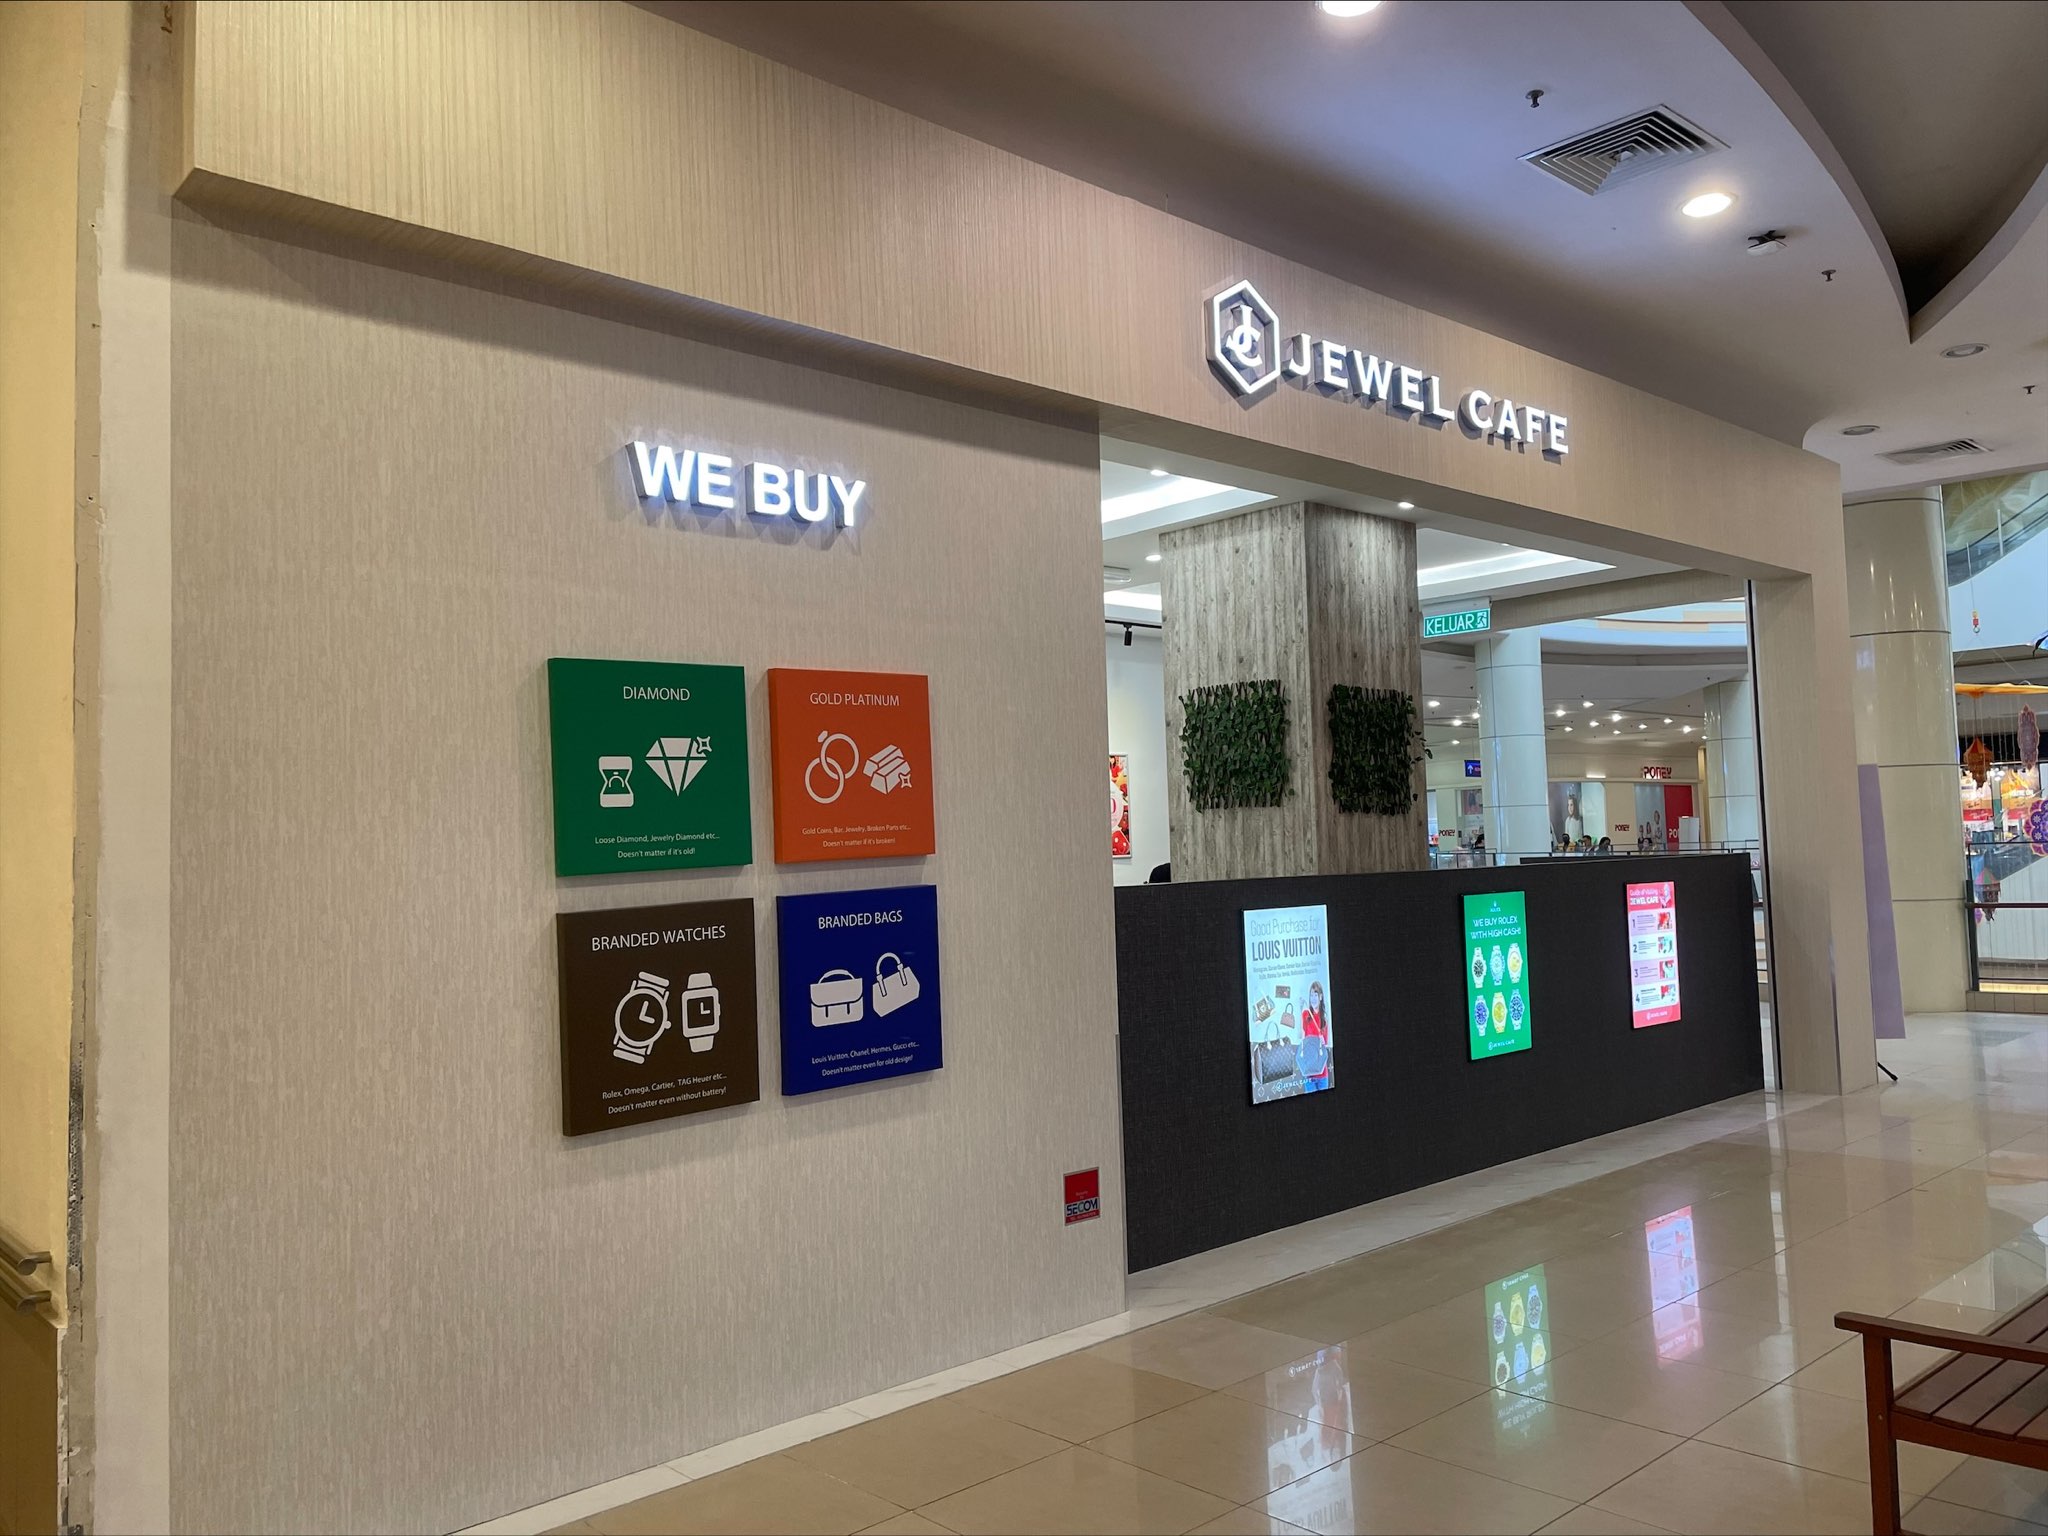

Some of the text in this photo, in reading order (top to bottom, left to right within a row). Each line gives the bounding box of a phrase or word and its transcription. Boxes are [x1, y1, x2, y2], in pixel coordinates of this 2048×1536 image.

[1288, 333, 1569, 455] JEWEL CAFE
[631, 441, 866, 528] WE BUY
[1426, 614, 1475, 635] KELUAR
[623, 686, 691, 701] DIAMOND
[810, 692, 900, 706] GOLD PLATINUM
[594, 836, 616, 845] Loose
[616, 835, 649, 844] Diamond,
[650, 834, 675, 844] Jewelry
[675, 832, 705, 841] Diamond
[802, 826, 816, 835] Gold
[823, 840, 844, 848] Doesn't
[876, 837, 896, 845] broken!
[617, 850, 644, 858] Doesn't
[645, 848, 667, 857] matter
[683, 847, 696, 855] old!
[818, 910, 903, 929] BRANDED BAGS
[1250, 919, 1271, 937] Good
[1272, 917, 1308, 935] Purchase
[1473, 915, 1518, 927] WE BUY ROLEX
[591, 925, 726, 951] BRANDED WATCHES
[1470, 930, 1487, 939] WITH
[1487, 929, 1503, 938] HIGH
[1251, 936, 1322, 961] LOUIS VUITTON
[811, 1057, 827, 1065] Louis
[870, 1046, 892, 1055] Hermes,
[892, 1043, 907, 1051] Gucci
[822, 1067, 843, 1076] Doesn't
[843, 1064, 862, 1073] matter
[862, 1062, 876, 1070] even
[894, 1055, 913, 1064] design!
[602, 1090, 623, 1100] Rolex,
[623, 1085, 650, 1096] Omega,
[651, 1081, 676, 1091] Cartier,
[677, 1077, 692, 1086] TAG
[692, 1075, 712, 1083] Heuer
[608, 1086, 727, 1114] Doesn't matter even without battery!
[1067, 1198, 1098, 1216] SECOM
